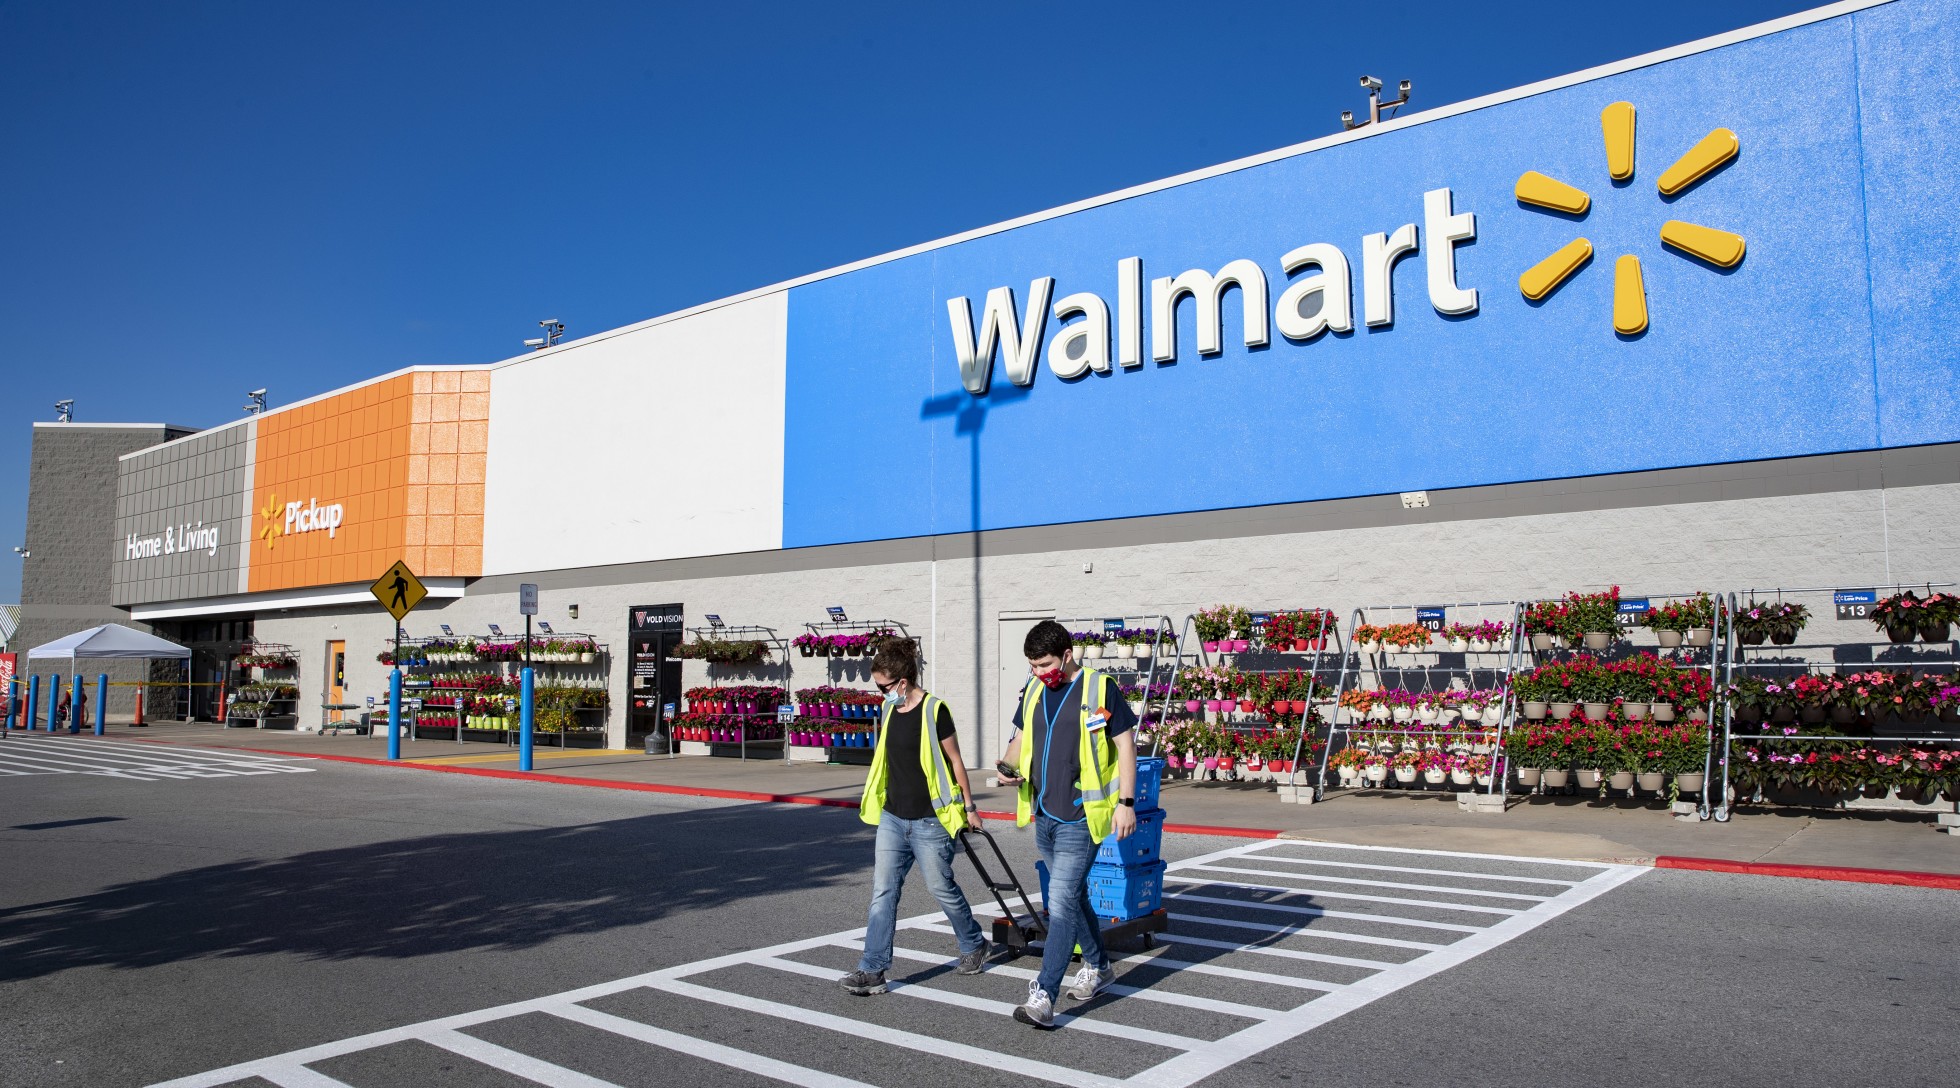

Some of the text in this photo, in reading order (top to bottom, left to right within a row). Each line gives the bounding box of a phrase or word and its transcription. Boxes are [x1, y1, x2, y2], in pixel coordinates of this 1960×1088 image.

[947, 187, 1479, 394] Walmart
[284, 497, 343, 539] Pickup
[126, 521, 218, 561] Home & Living
[646, 614, 684, 624] VOLD VISION
[1422, 620, 1439, 630] $10
